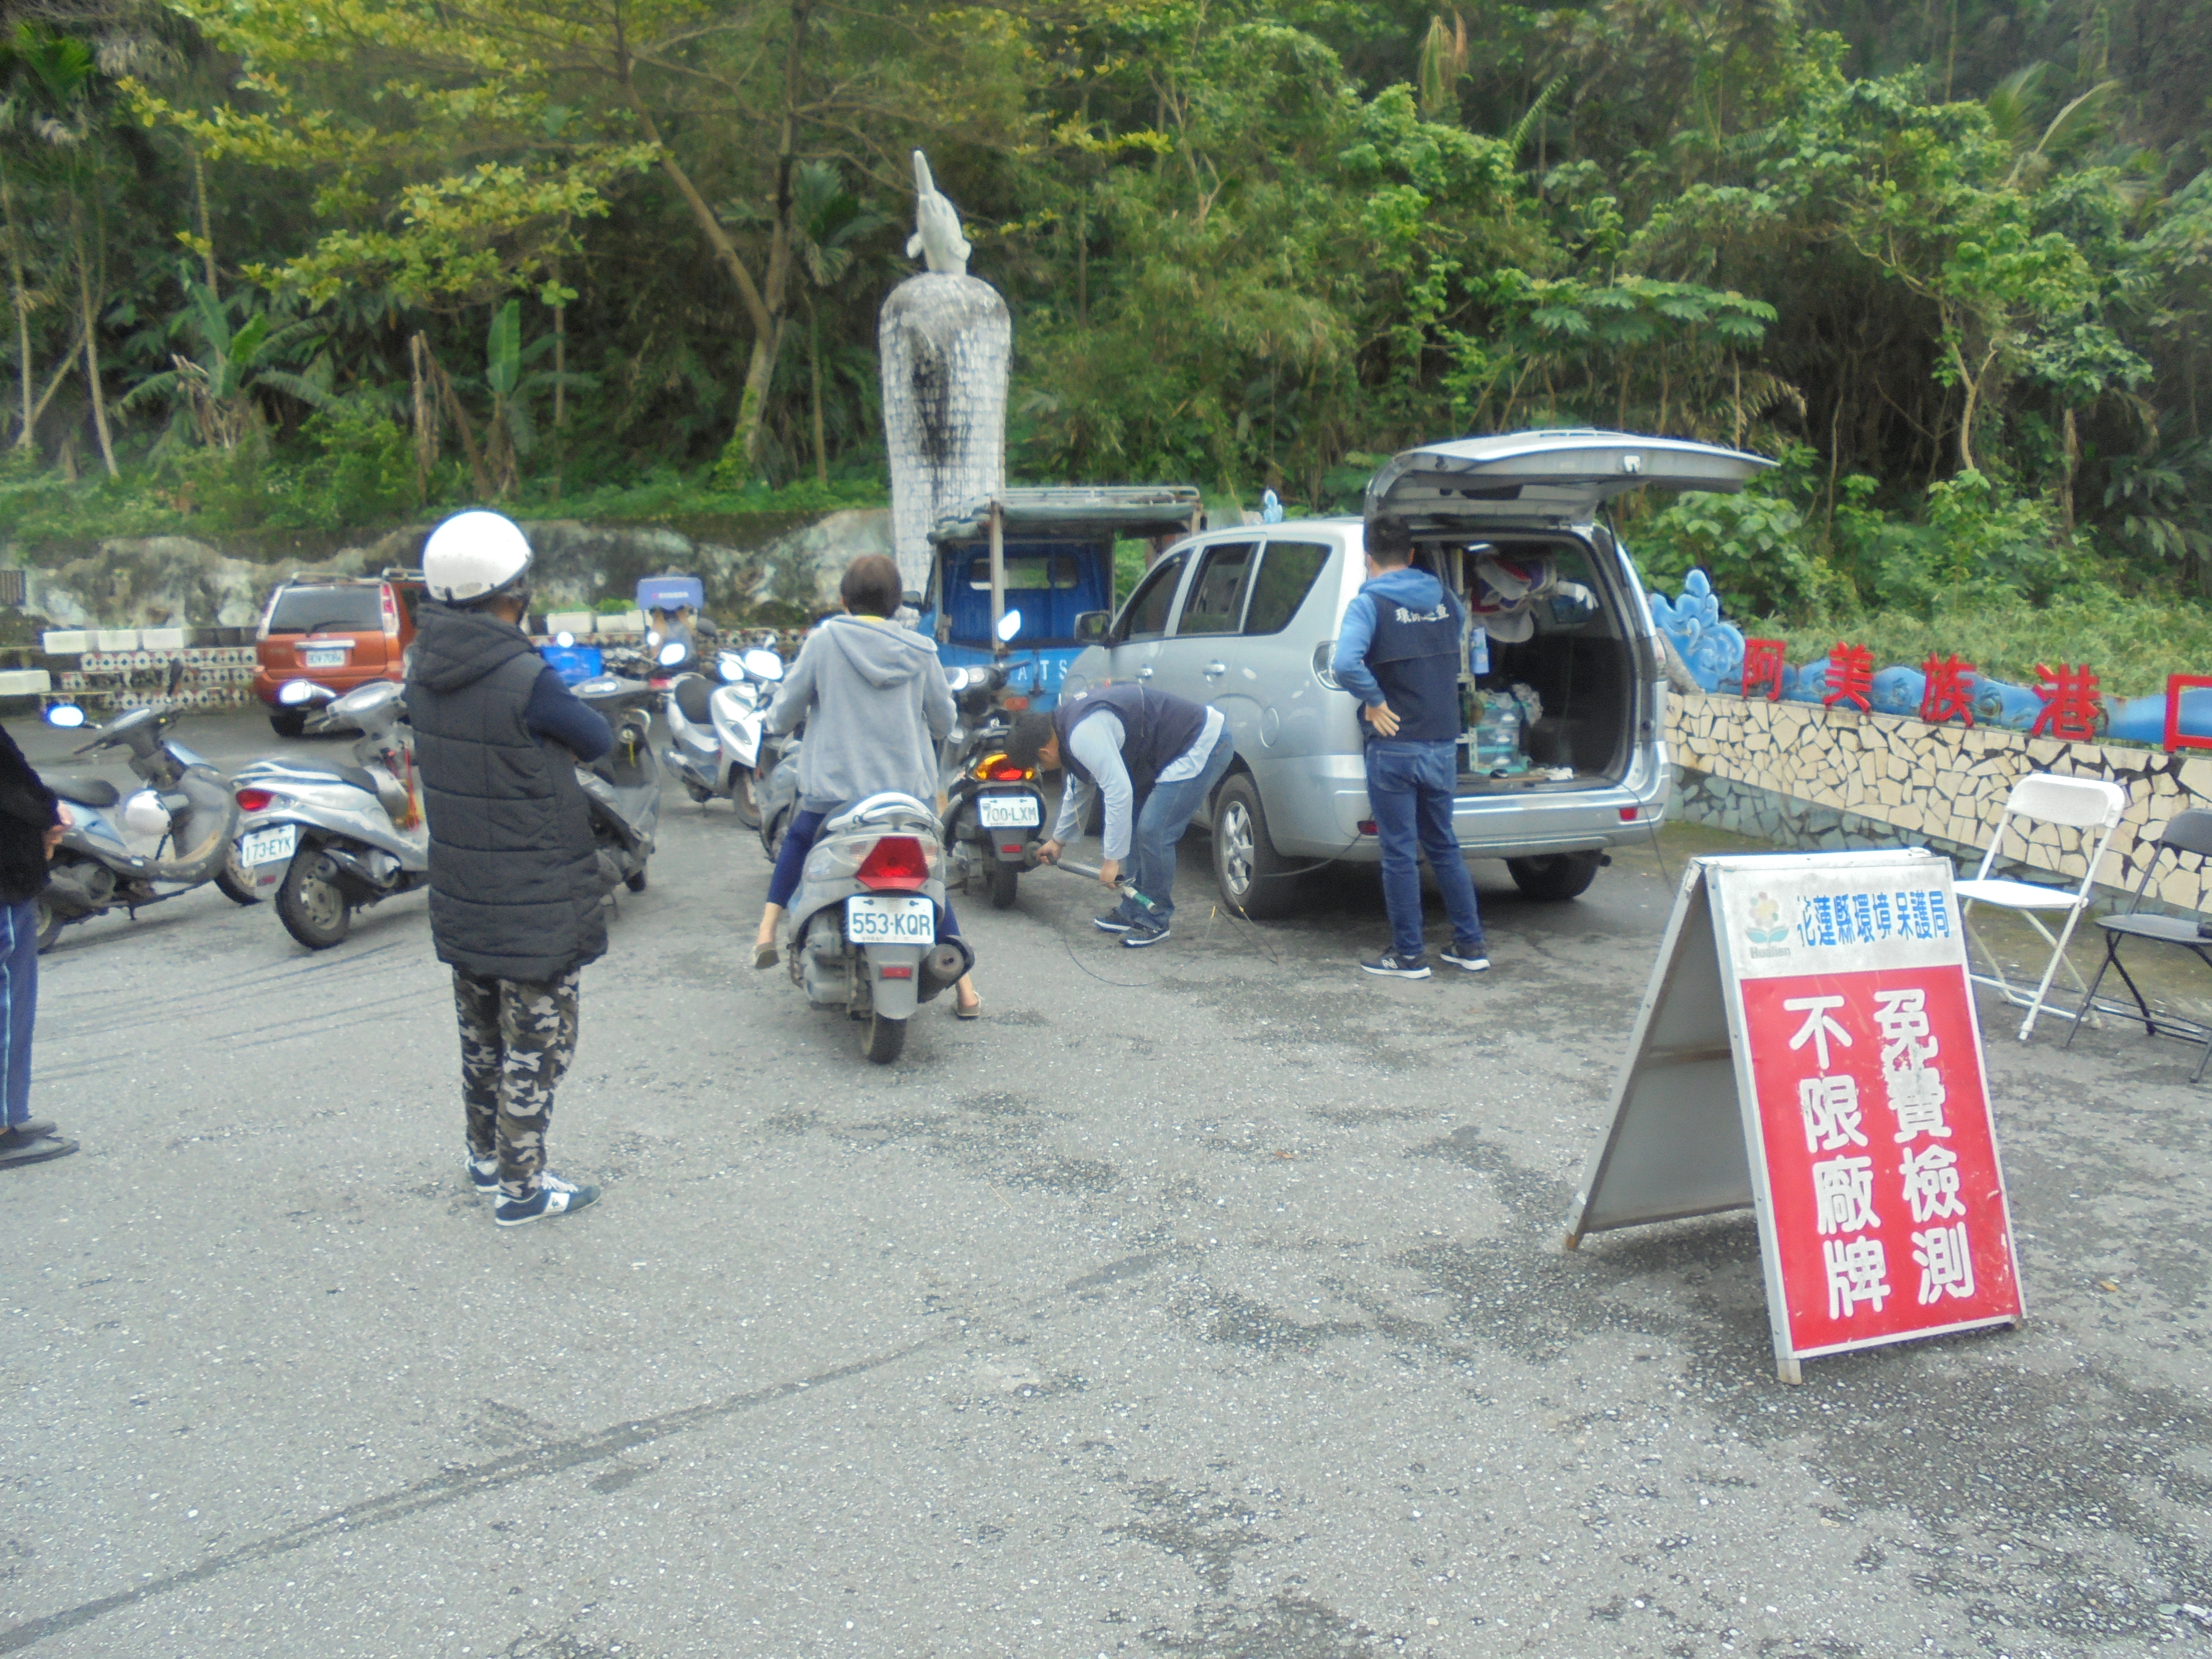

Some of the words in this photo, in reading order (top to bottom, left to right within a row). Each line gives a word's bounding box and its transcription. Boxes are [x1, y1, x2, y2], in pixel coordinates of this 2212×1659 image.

[853, 913, 930, 936] 553-KQR
[1750, 946, 1791, 959] Hualien
[1784, 995, 1891, 1320] 不限廠牌
[1874, 988, 1975, 1305] 免費檢測
